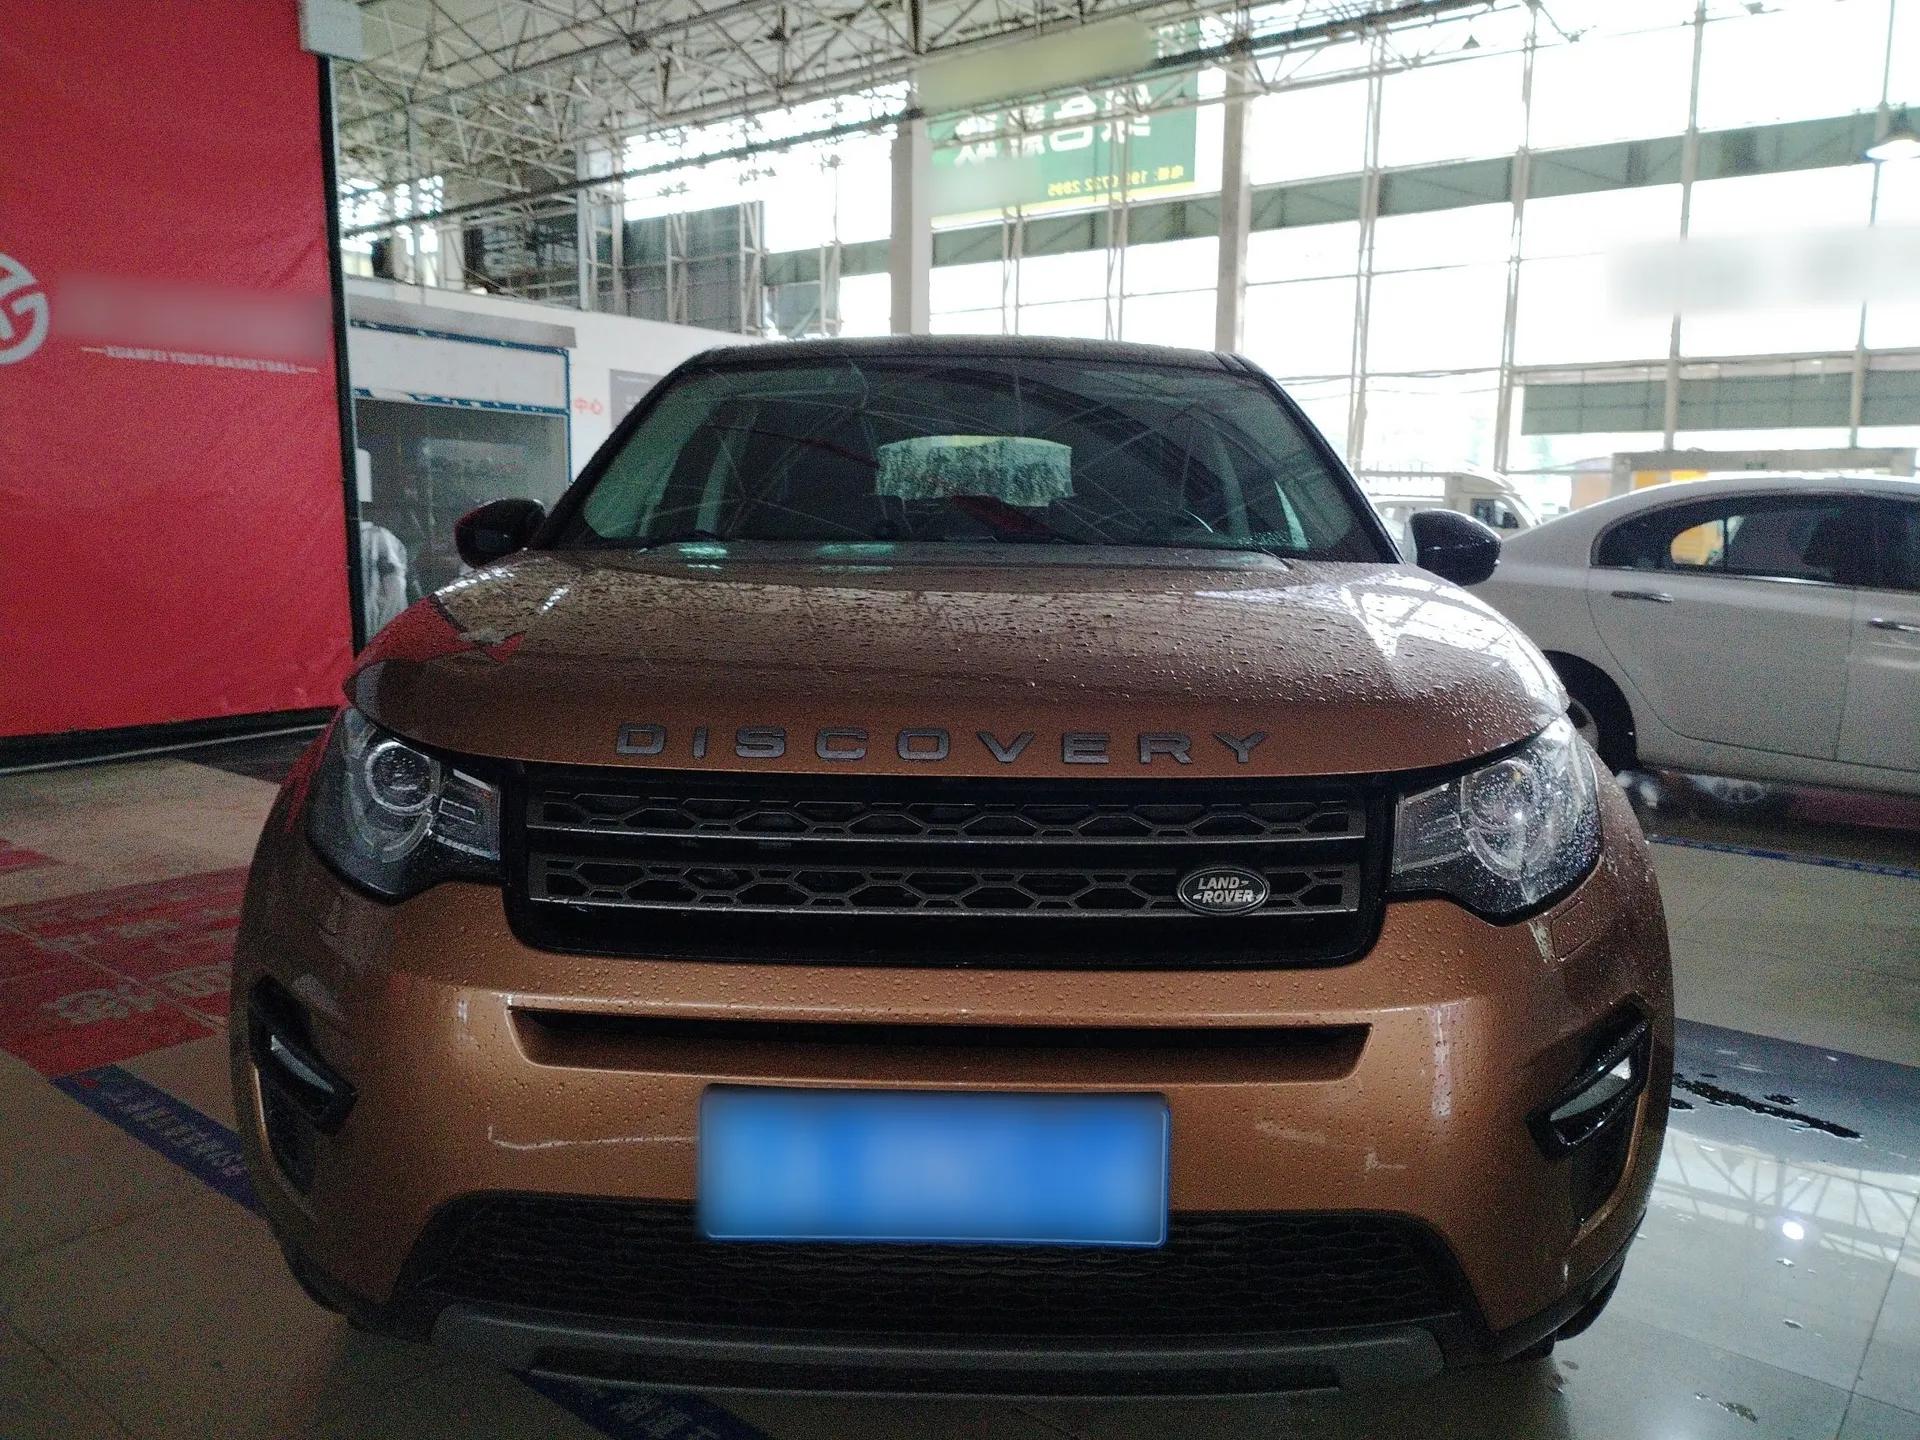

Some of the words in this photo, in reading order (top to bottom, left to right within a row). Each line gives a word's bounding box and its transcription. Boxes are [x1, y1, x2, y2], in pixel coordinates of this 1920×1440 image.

[616, 723, 1267, 764] DISCOVERY
[1198, 876, 1240, 890] LAND
[1202, 889, 1255, 903] ROVER
